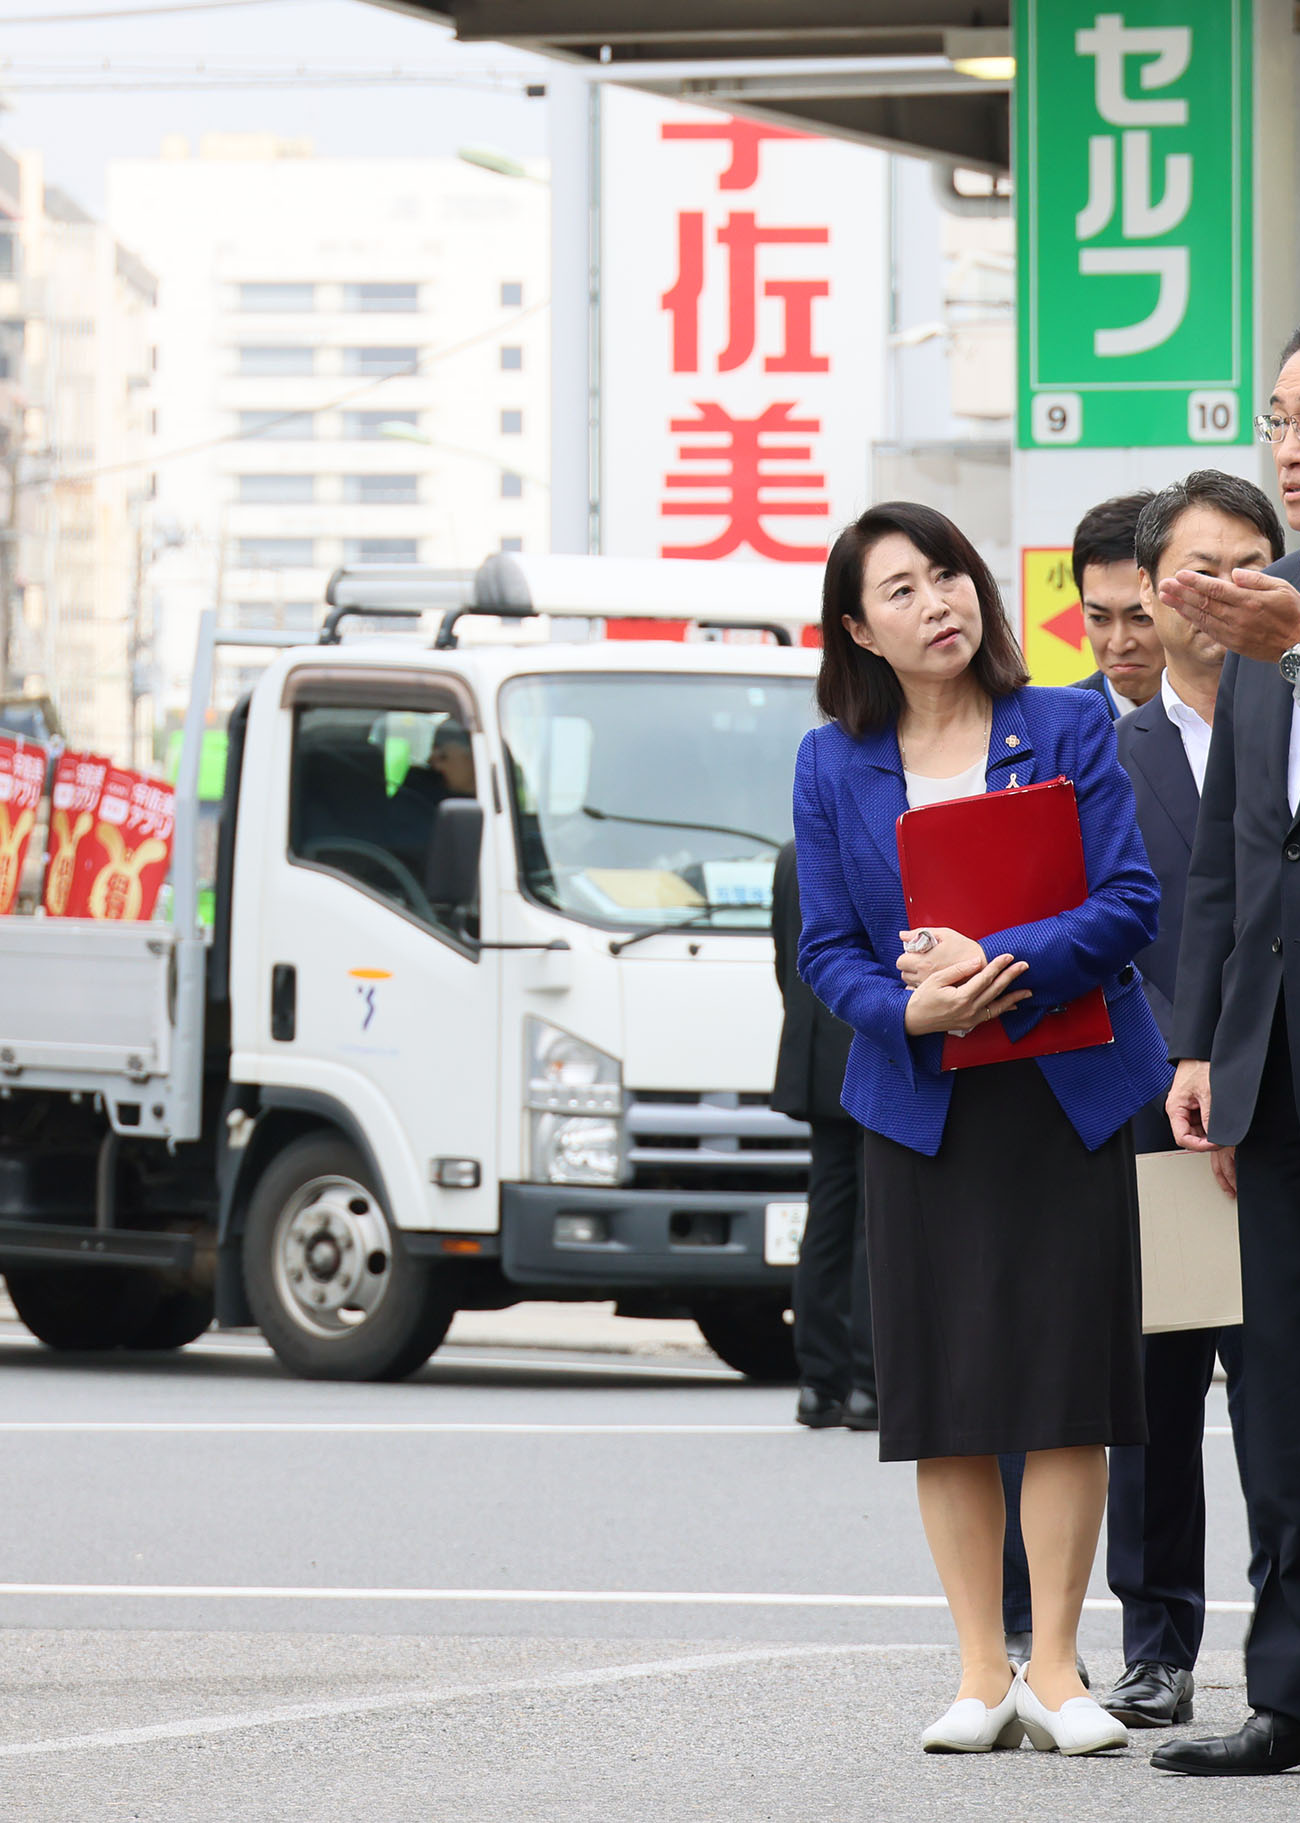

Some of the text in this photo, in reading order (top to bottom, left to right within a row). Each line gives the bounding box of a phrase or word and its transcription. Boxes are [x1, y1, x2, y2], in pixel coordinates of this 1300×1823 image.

[1074, 14, 1193, 357] セルフ
[1046, 408, 1067, 433] 9
[1195, 403, 1230, 432] 10
